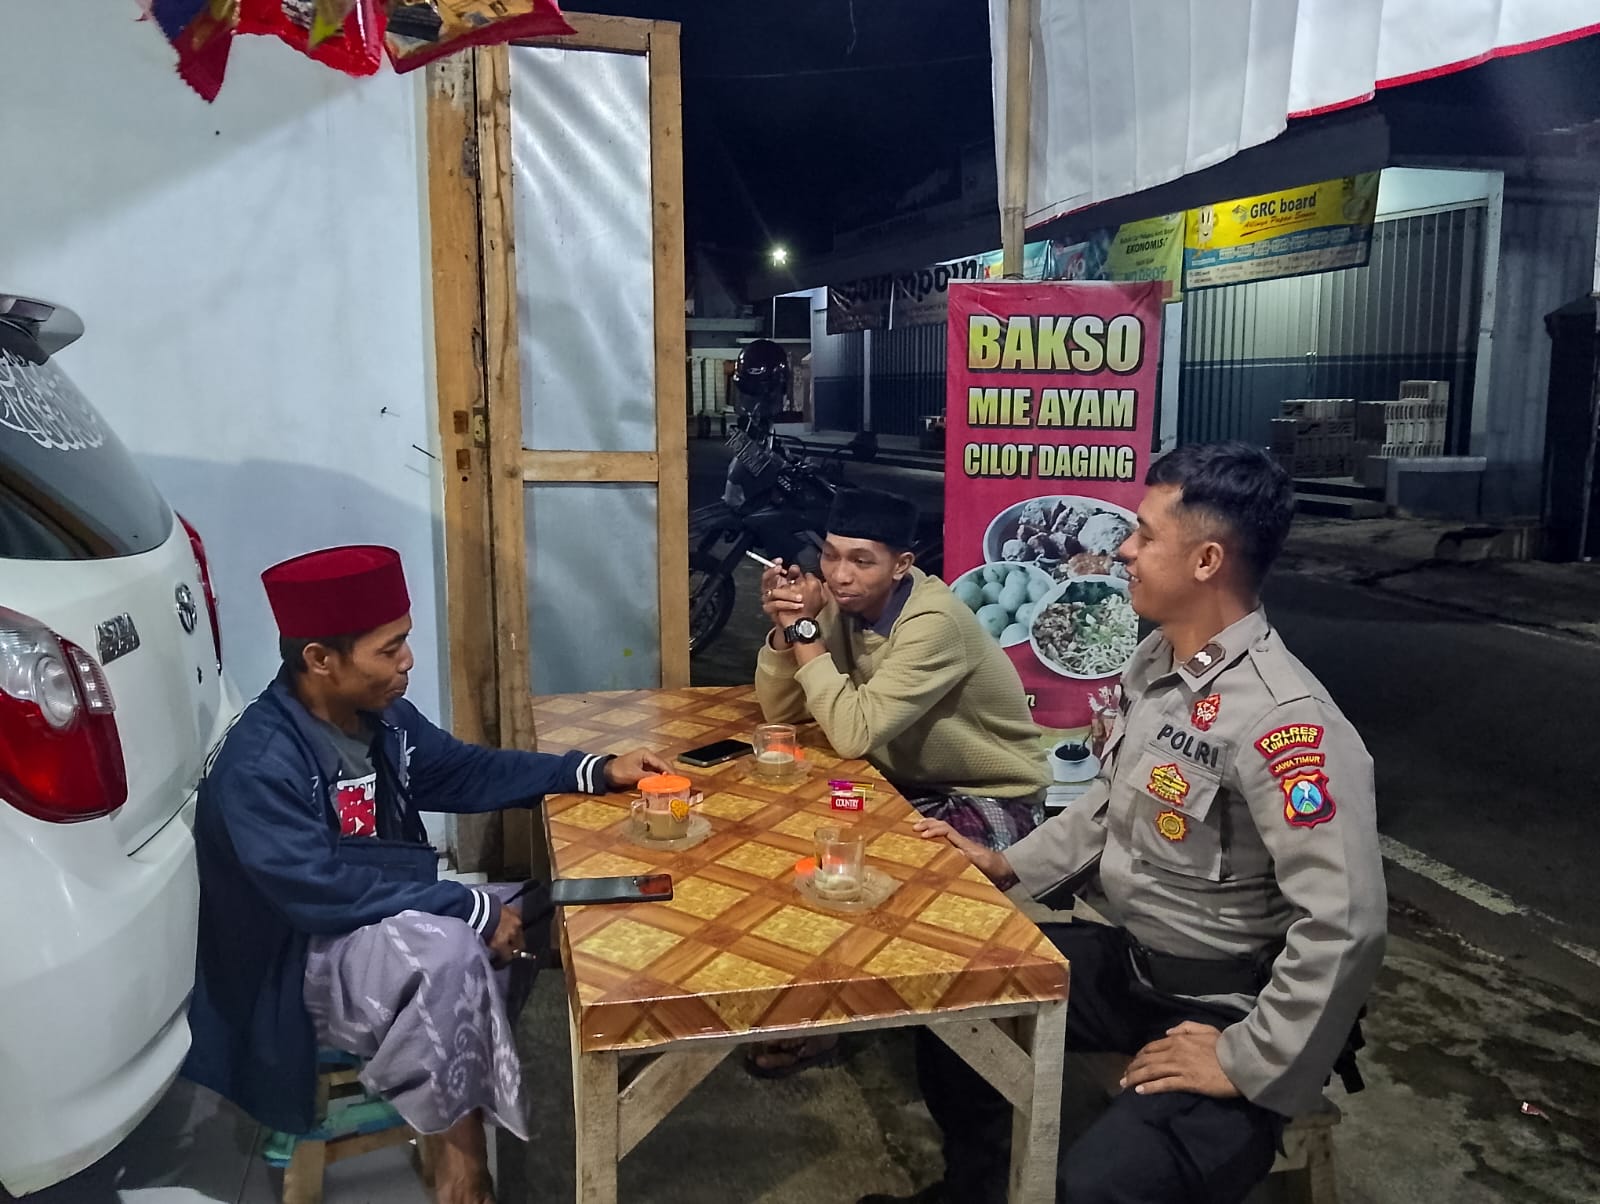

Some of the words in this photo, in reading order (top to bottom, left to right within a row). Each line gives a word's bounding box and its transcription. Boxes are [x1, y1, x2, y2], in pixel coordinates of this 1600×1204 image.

[1250, 200, 1276, 219] GRC
[1280, 192, 1317, 213] board
[968, 314, 1143, 375] BAKSO
[968, 387, 1032, 427] MIE
[1037, 388, 1137, 429] AYAM
[964, 443, 1033, 478] CILOT
[1038, 444, 1135, 480] DAGING
[1157, 724, 1219, 768] POLRI
[1260, 726, 1318, 749] POLRES
[1266, 734, 1315, 753] LUMAJANG
[1274, 760, 1295, 773] JAWA
[1294, 755, 1321, 765] TIMUR
